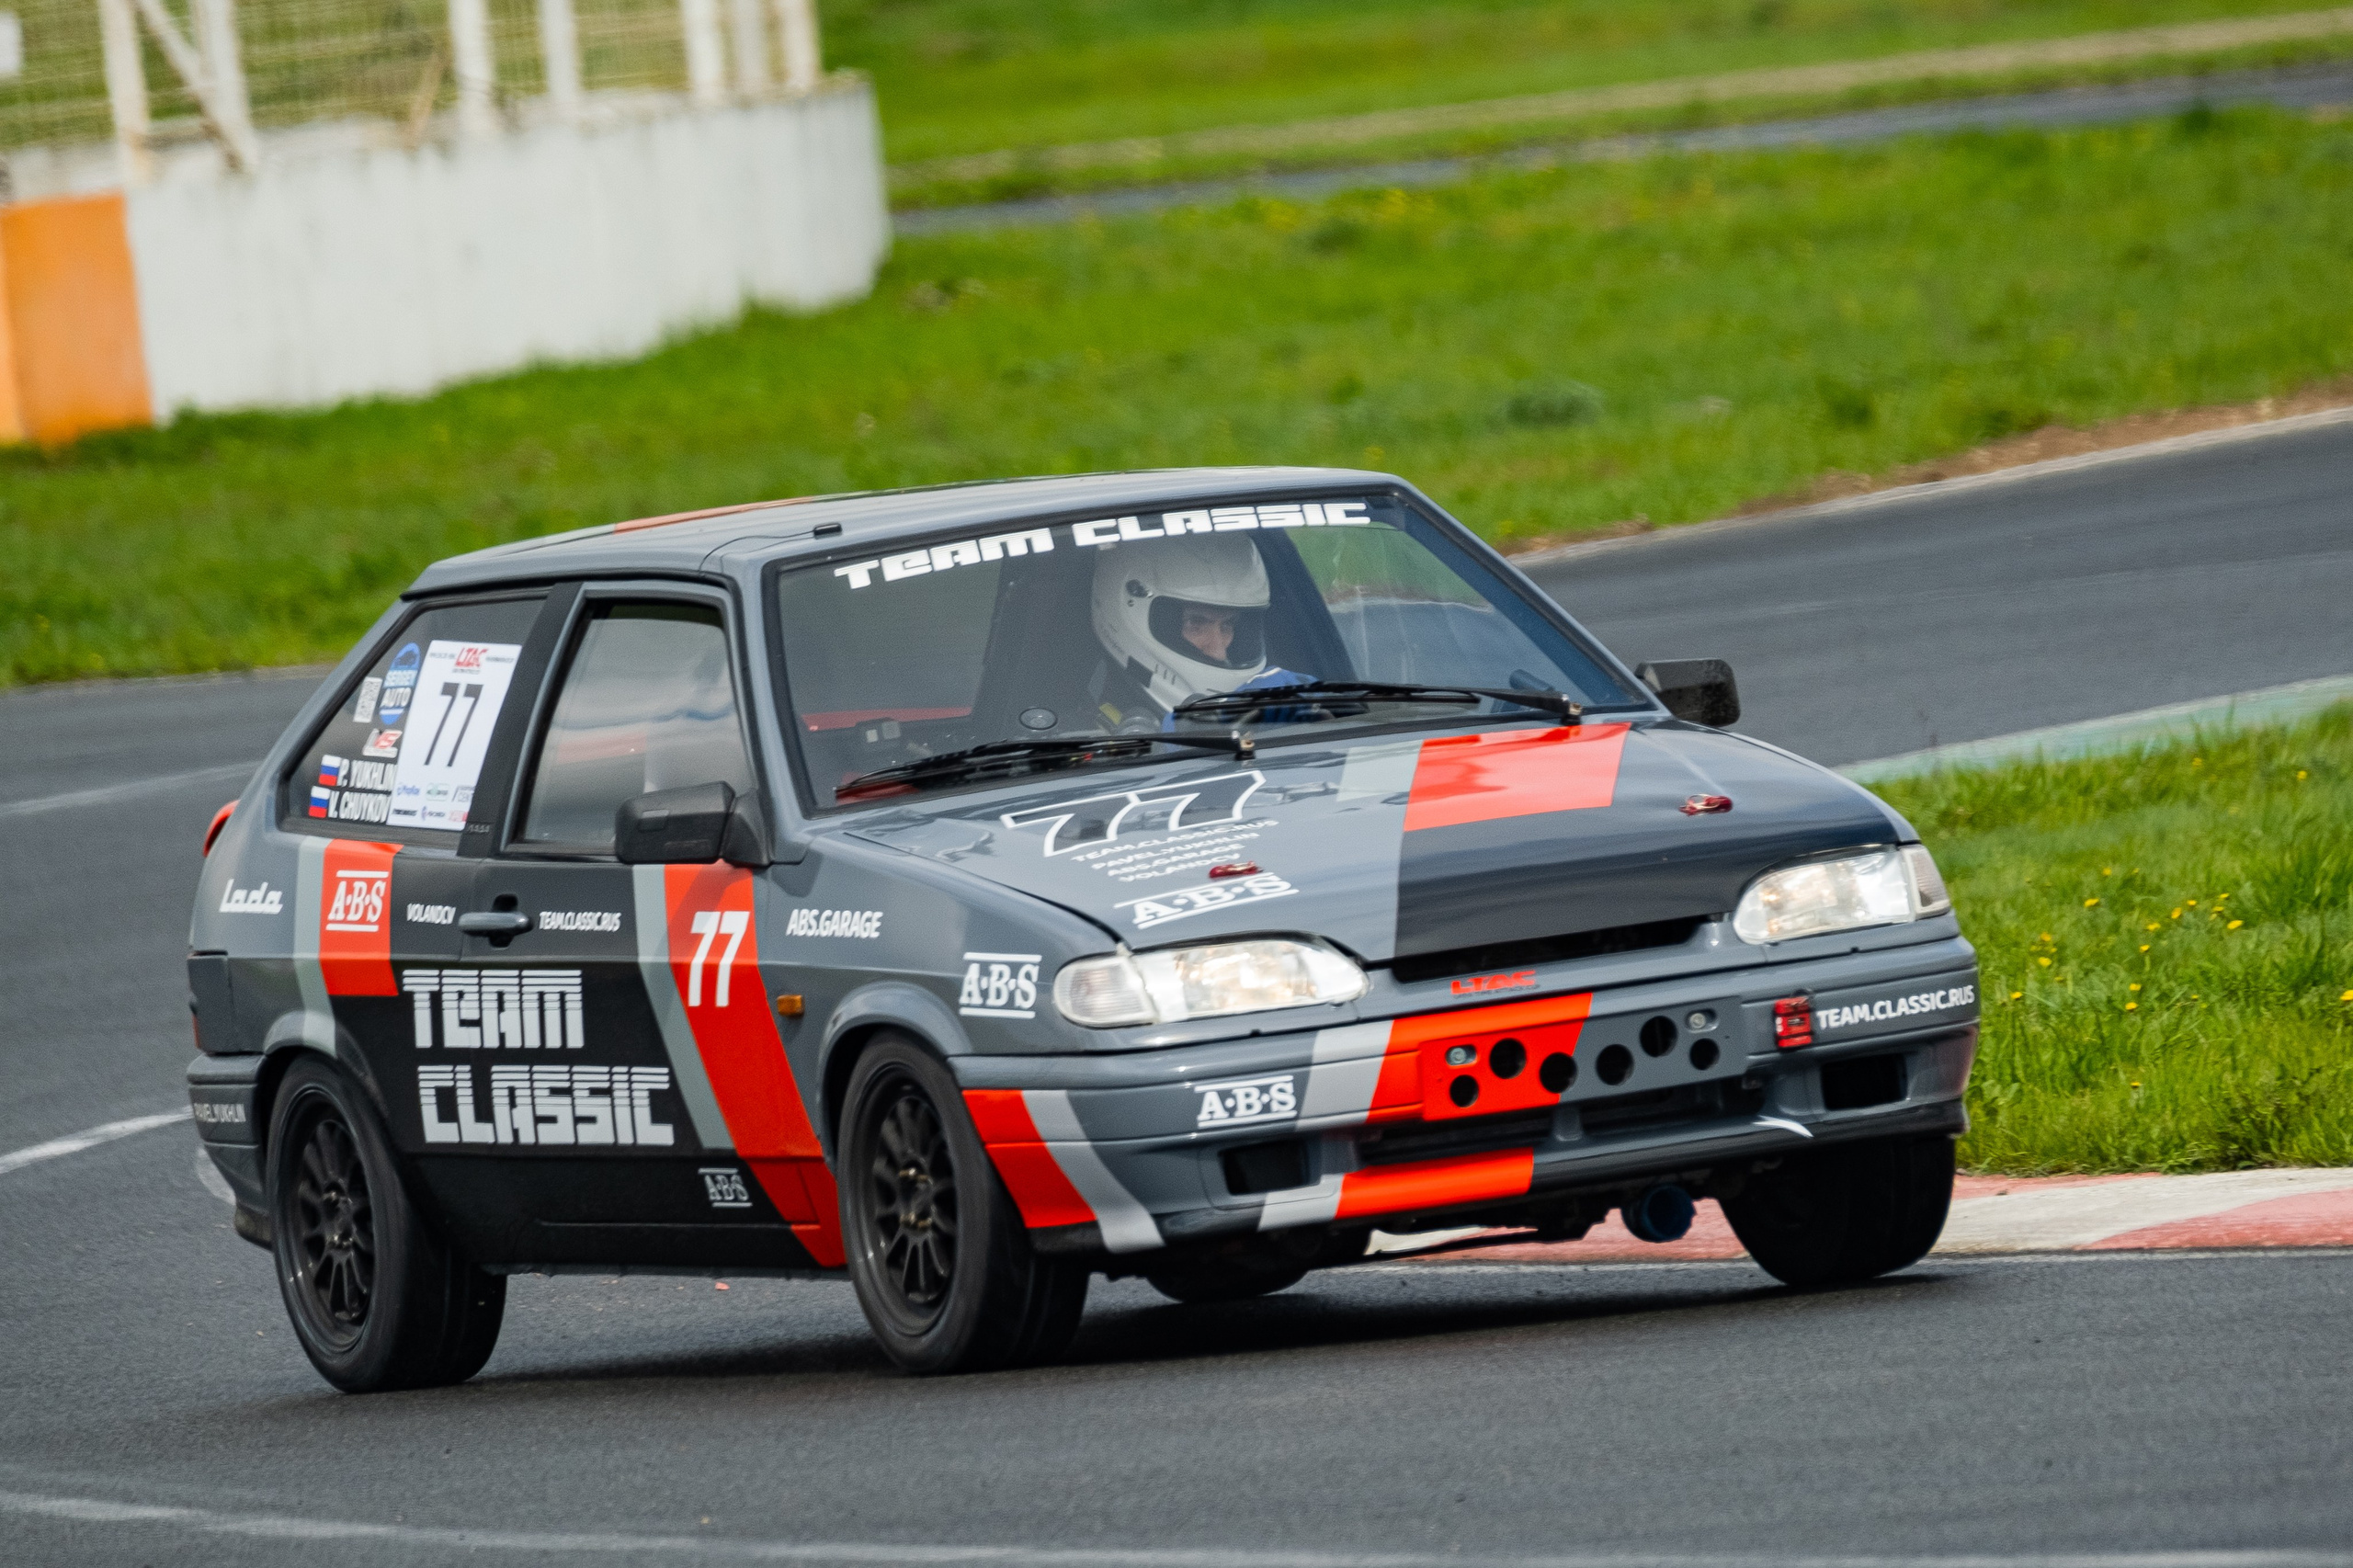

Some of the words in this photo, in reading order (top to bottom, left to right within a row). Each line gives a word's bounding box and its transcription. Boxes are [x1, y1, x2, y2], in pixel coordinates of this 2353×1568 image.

[1073, 503, 1371, 547] CLASSIC
[380, 687, 412, 709] AUTO
[424, 681, 484, 767] 77
[219, 878, 283, 915] Lada
[785, 908, 883, 938] ABS.GARAGE
[688, 911, 750, 1008] 77
[1450, 970, 1536, 994] LTAC
[1816, 984, 1975, 1030] TEAM.CLASSIC.RUS
[417, 1064, 674, 1145] CLASSIC
